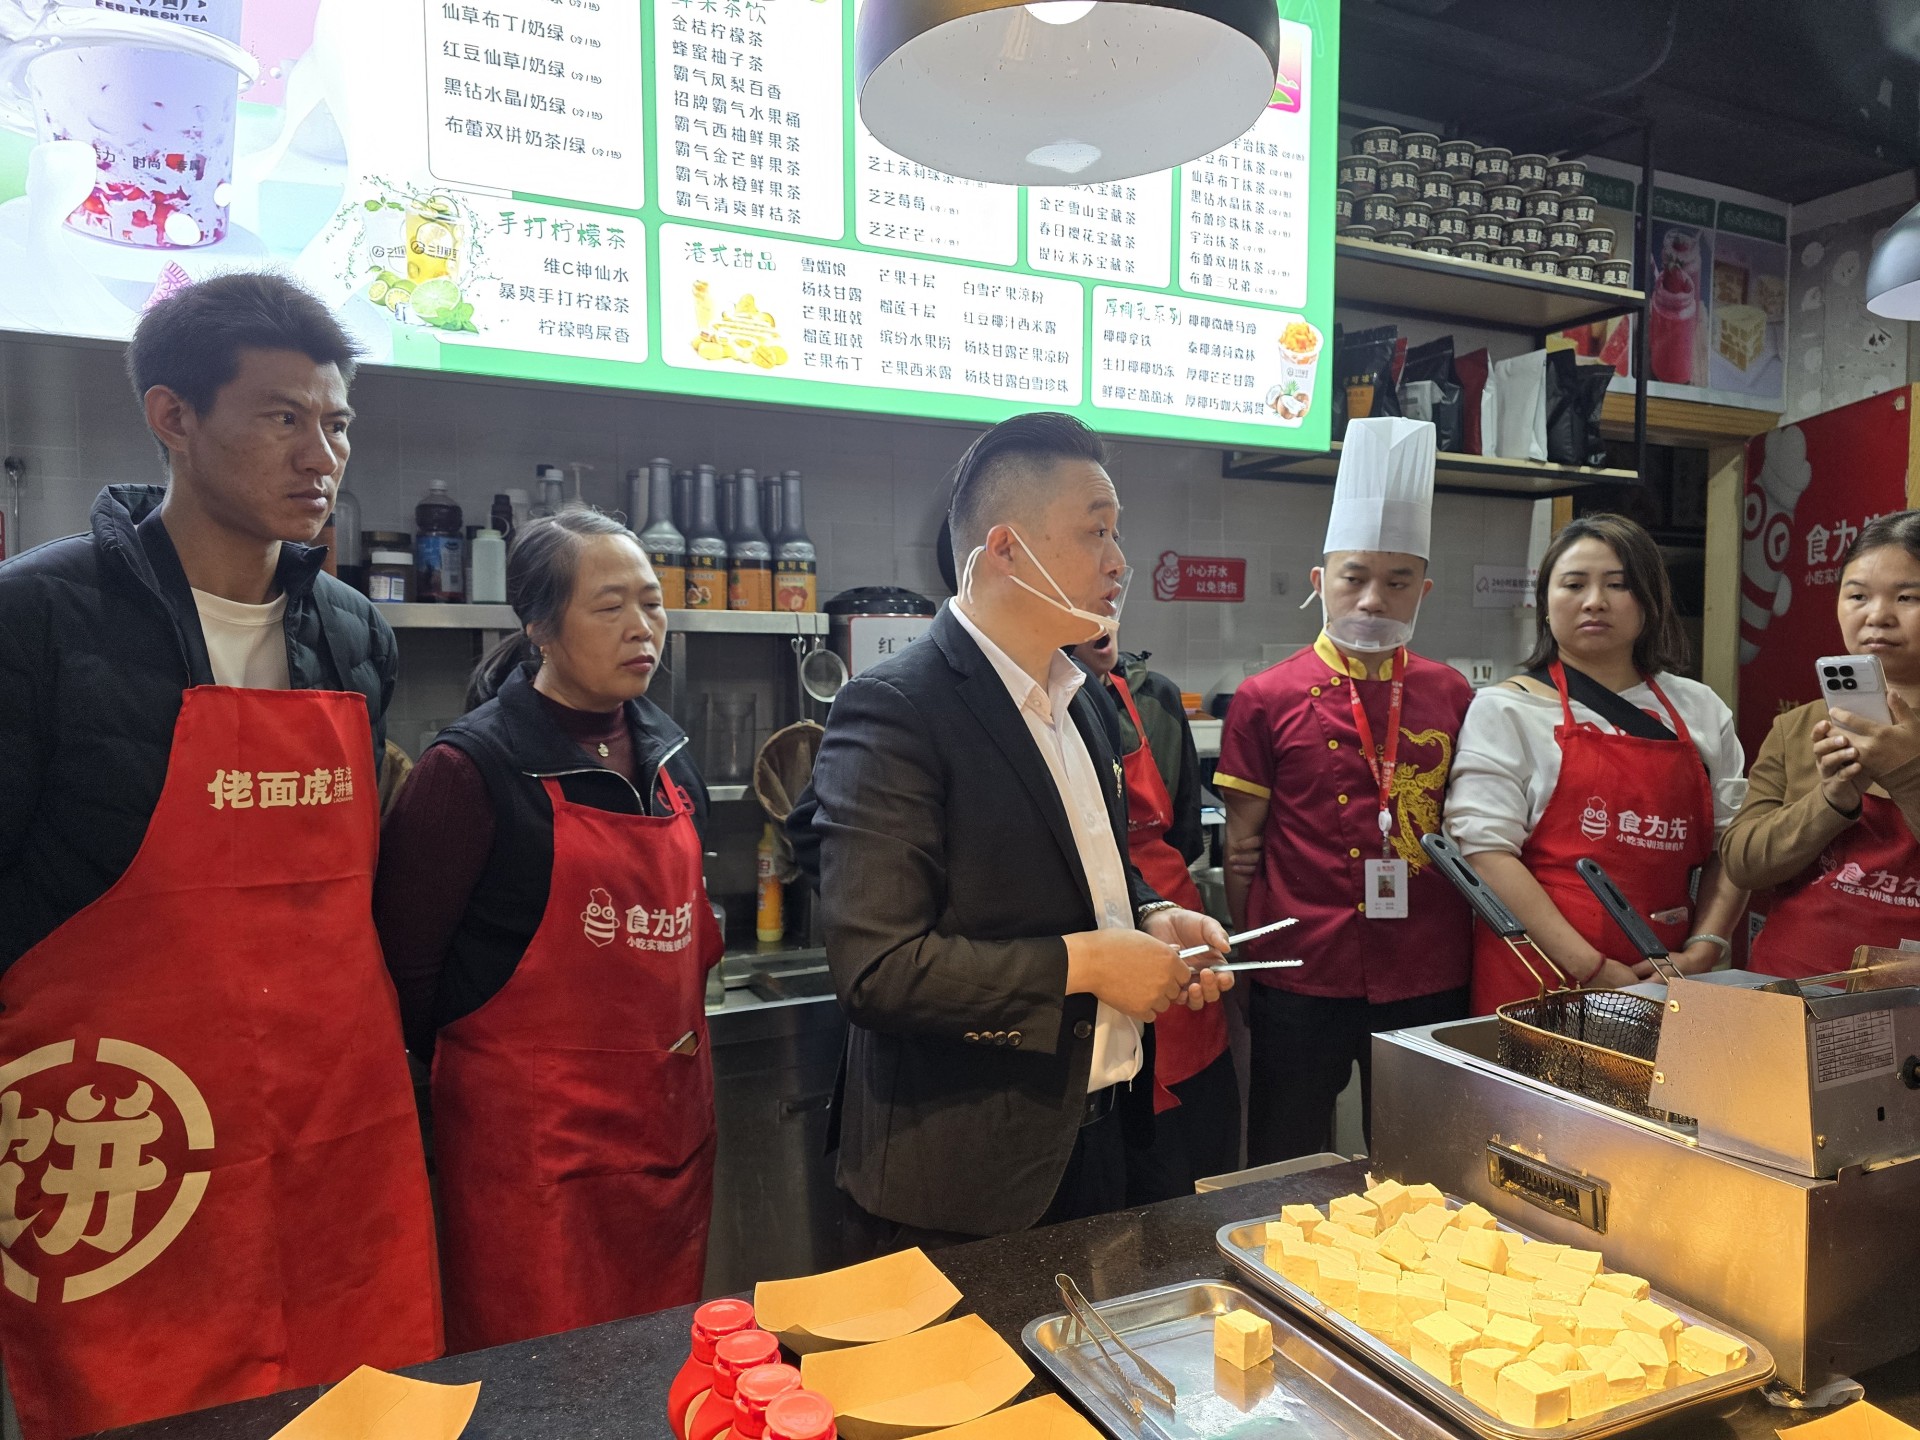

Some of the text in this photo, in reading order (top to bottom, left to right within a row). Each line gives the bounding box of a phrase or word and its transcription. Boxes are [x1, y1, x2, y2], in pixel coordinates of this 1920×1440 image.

[130, 6, 179, 20] FRESH
[183, 14, 208, 22] TEA
[442, 3, 564, 41] 仙草布丁/奶绿
[672, 14, 763, 47] 金桔柠檬茶
[443, 40, 566, 78] 红豆仙草/奶绿
[672, 40, 763, 72] 蜂蜜柚子茶
[673, 64, 781, 100] 霸气凤梨百香
[444, 77, 566, 115] 黑钻水晶/奶绿
[674, 89, 800, 129] 招牌霸气水果桶
[445, 115, 586, 154] 布蕾双拼奶茶/绿
[674, 115, 800, 152] 霸气西柚鲜果茶
[675, 140, 800, 176] 霸气金芒鲜果茶
[1195, 155, 1266, 176] 豆布丁抹茶
[676, 165, 801, 200] 霸气冰橙鲜果茶
[1191, 169, 1266, 195] 仙草布丁抹茶
[1391, 172, 1418, 188] 臭豆
[676, 190, 801, 224] 霸气清爽鲜桔茶
[1040, 197, 1136, 225] 金芒雪山宝藏茶
[1191, 189, 1265, 215] 黑钻水晶抹茶
[498, 211, 626, 249] 手打柠檬茶
[869, 221, 926, 243] 芝芝芒芒
[1039, 221, 1136, 249] 春日樱花宝藏茶
[1190, 231, 1239, 251] 宇治抹茶
[684, 241, 777, 272] 港式甜品
[801, 256, 846, 277] 雪媚娘
[1039, 246, 1135, 273] 提拉米苏宝藏茶
[544, 257, 630, 283] 维C神仙水
[879, 268, 936, 289] 芒果千层
[499, 283, 630, 314] 暴爽手打柠檬茶
[802, 281, 863, 303] 杨枝甘露
[803, 305, 863, 326] 芒果班戟
[880, 298, 936, 319] 榴莲千层
[538, 319, 630, 343] 柠檬鸭屎香
[963, 311, 1056, 335] 红豆椰汁西米露
[803, 328, 864, 350] 榴莲班戟
[880, 329, 951, 351] 缤纷水果捞
[1103, 328, 1152, 347] 椰椰拿铁
[804, 351, 863, 372] 芒果布丁
[964, 340, 1070, 366] 杨枝甘露芒果凉粉
[881, 360, 953, 381] 芒果西米露
[965, 369, 1069, 394] 杨枝甘露白雪珍珠
[1186, 564, 1228, 577] 小心开水
[1196, 581, 1237, 594] 以免烫伤
[208, 768, 333, 810] 佬面虎
[1618, 809, 1688, 840] 食为先
